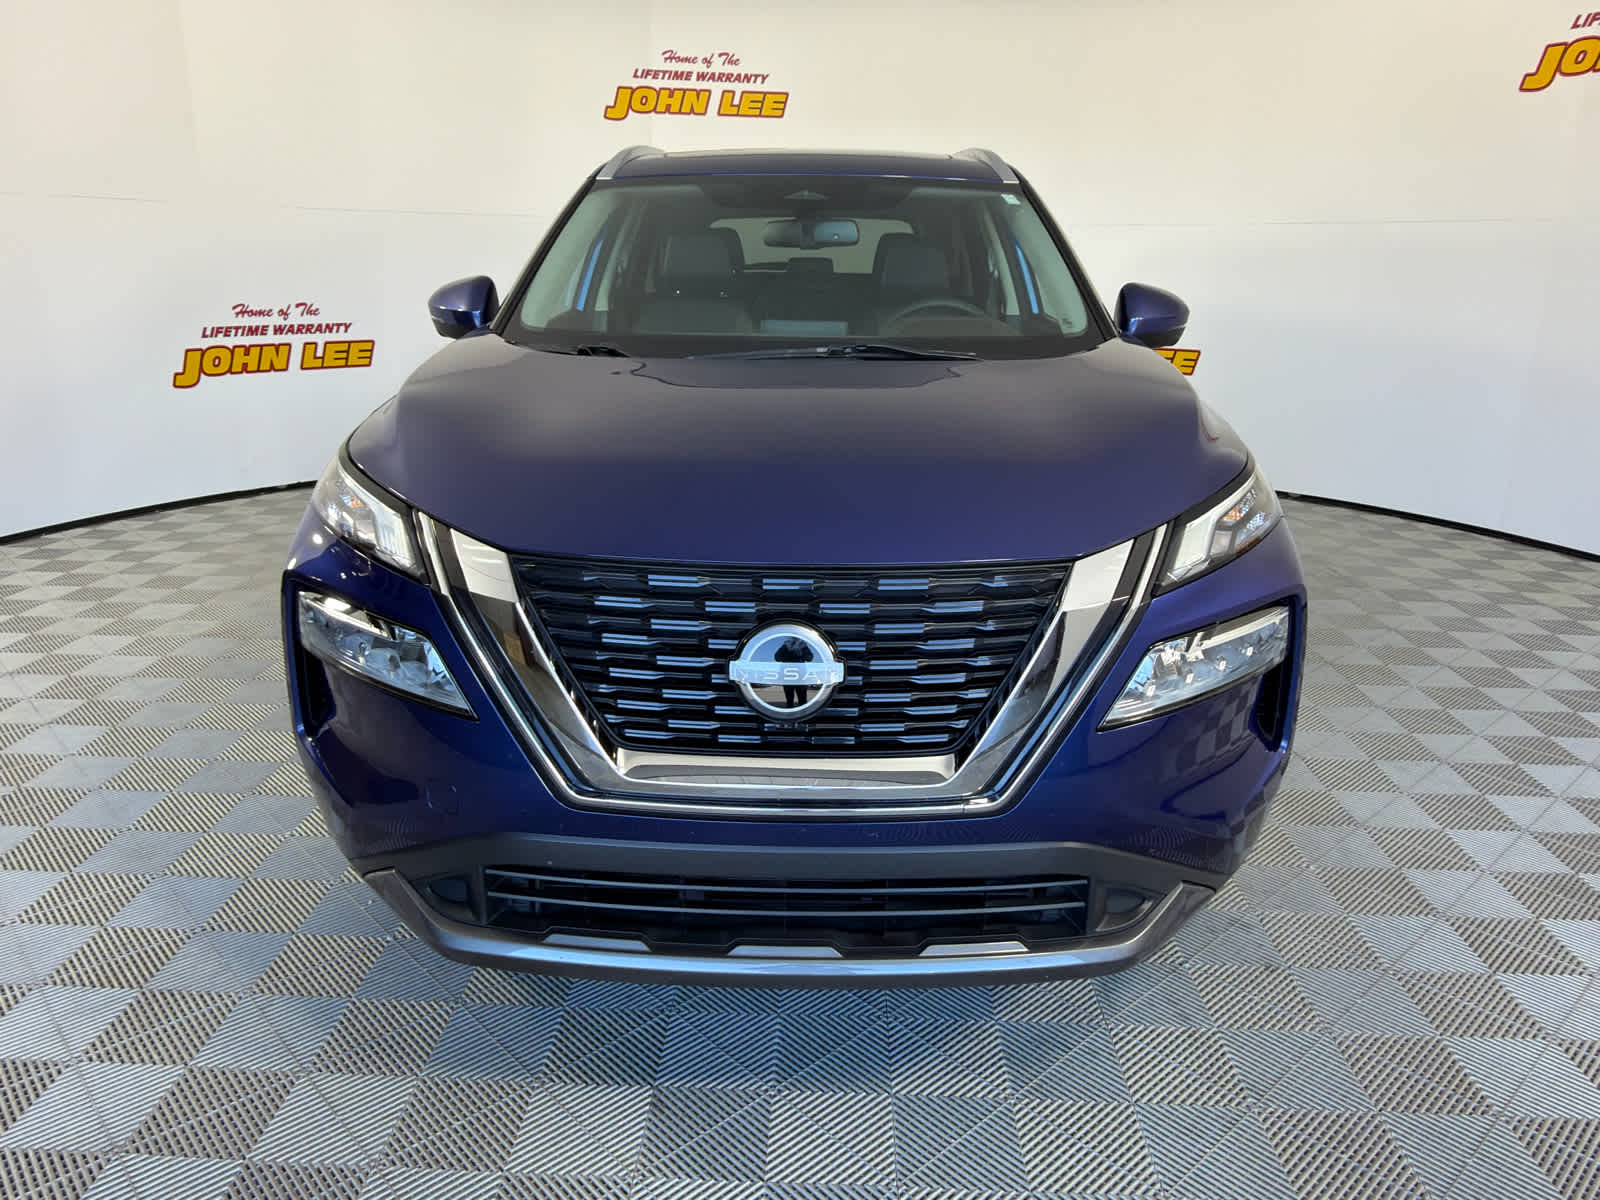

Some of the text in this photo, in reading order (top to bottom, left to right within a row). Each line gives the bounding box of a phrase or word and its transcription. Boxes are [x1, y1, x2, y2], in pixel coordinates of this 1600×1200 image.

[1570, 11, 1600, 30] LIF
[661, 49, 741, 69] Home of The
[1518, 35, 1600, 92] JO
[632, 68, 770, 85] LIFETIME WARRANTY
[603, 85, 789, 121] JOHN LEE
[231, 302, 321, 321] Home of The
[201, 322, 353, 339] LIFETIME WARRANTY
[172, 339, 375, 389] JOHN LEE
